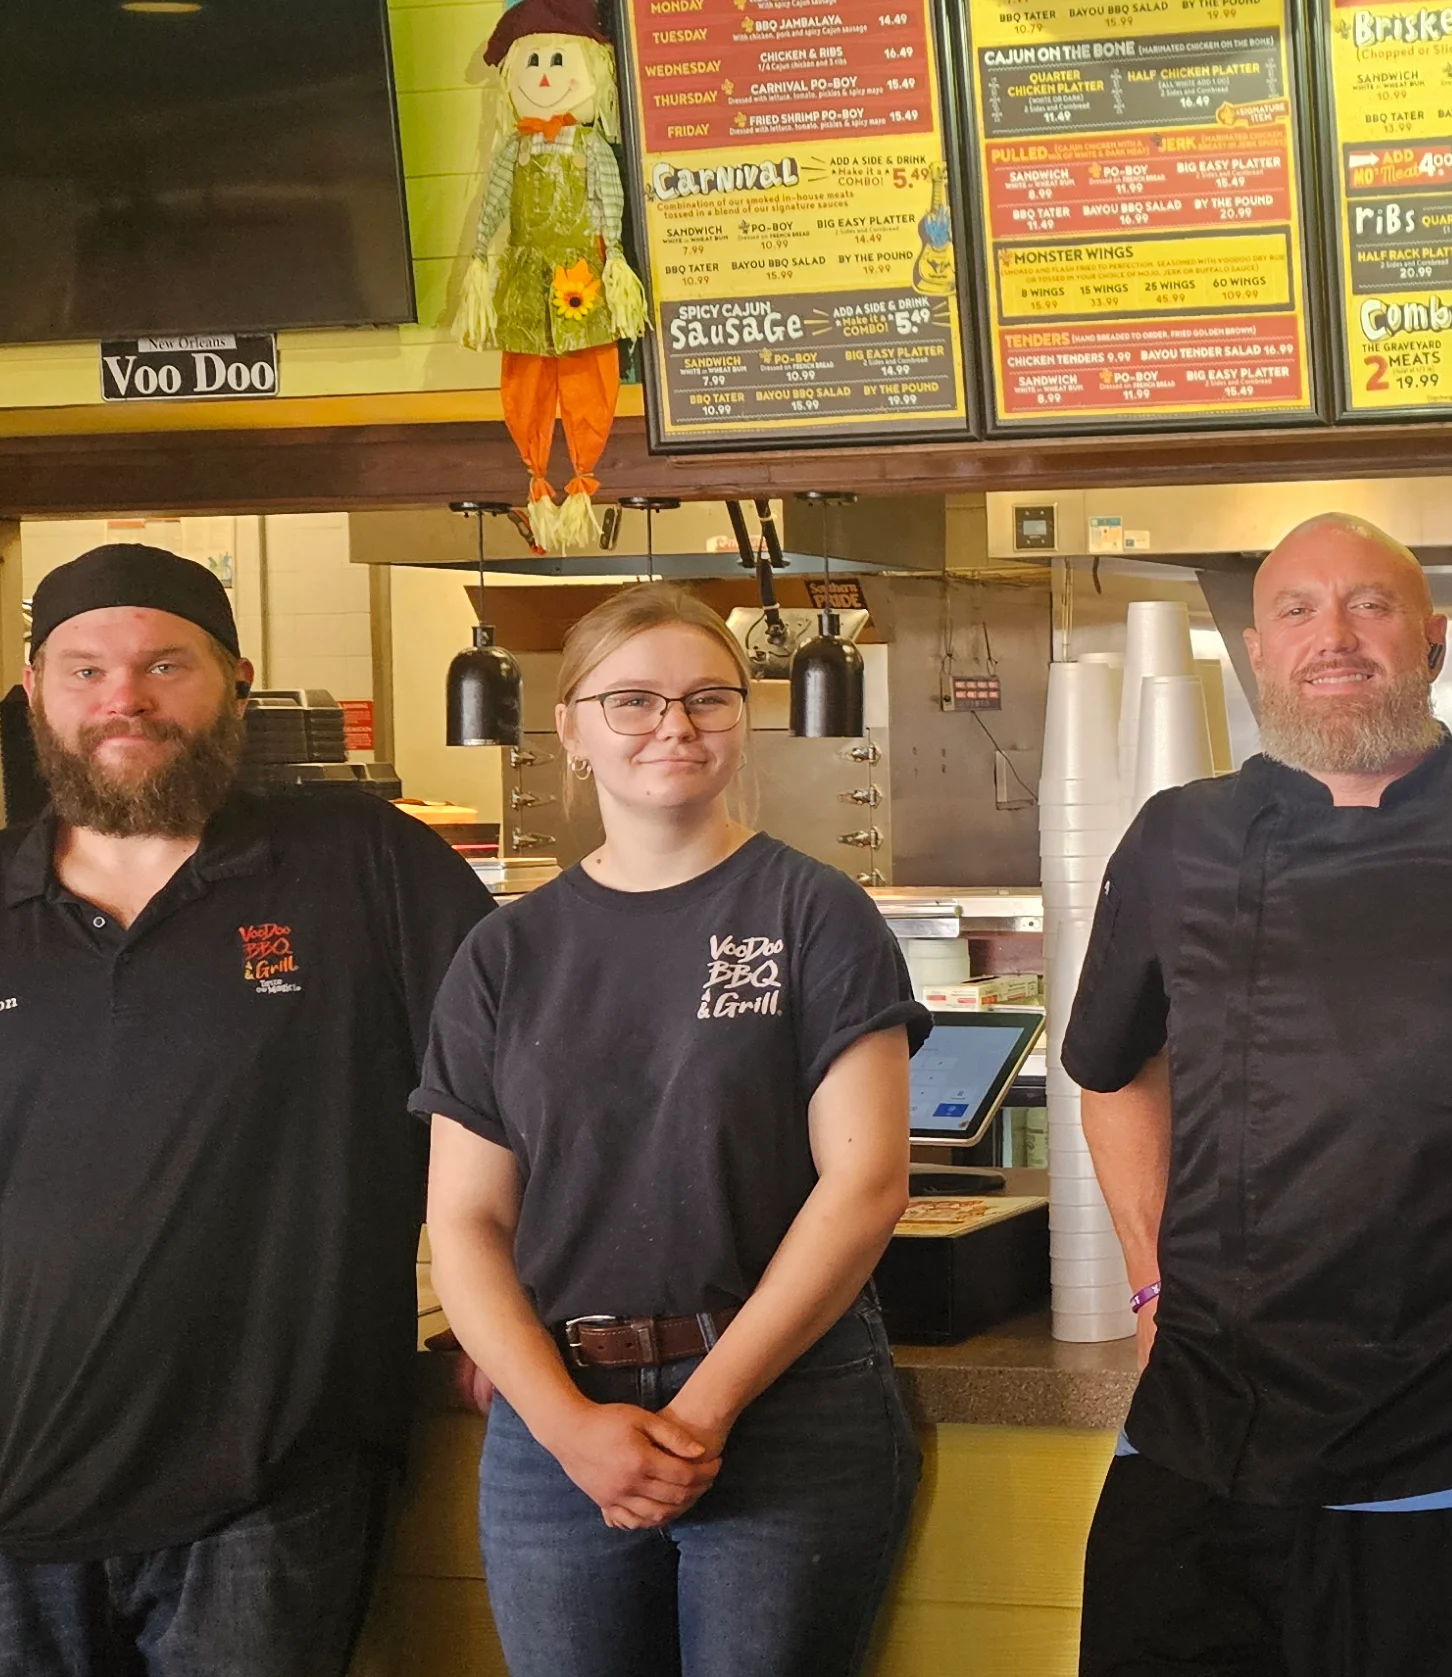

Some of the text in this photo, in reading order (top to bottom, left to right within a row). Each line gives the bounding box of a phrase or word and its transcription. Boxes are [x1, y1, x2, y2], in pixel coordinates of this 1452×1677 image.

[650, 0, 703, 14] MONDAY
[755, 15, 842, 32] BBQ JAMBALAYA
[878, 14, 908, 26] 14.49
[652, 28, 708, 44] TUESDAY
[760, 46, 843, 62] CHICKEN & RIBS
[884, 47, 914, 59] 16.49
[984, 41, 1135, 65] CAJUN ON THE BONE
[1356, 47, 1414, 61] (Chopped
[1418, 47, 1429, 55] or
[645, 60, 721, 77] WEDNESDAY
[1030, 70, 1080, 83] QUARTER
[1007, 80, 1105, 97] CHICKEN PLATTER
[653, 91, 718, 107] THURSDAY
[749, 108, 864, 126] FRIED SHRIMP PO-BOY
[889, 110, 918, 122] 15.49
[1044, 111, 1072, 122] 11.49
[667, 123, 710, 138] FRIDAY
[1159, 136, 1197, 152] JERK
[991, 146, 1048, 163] PULLED
[1382, 149, 1414, 164] ADD
[657, 200, 714, 211] Combination
[746, 195, 780, 205] smoked
[782, 193, 825, 202] in-house
[827, 191, 854, 199] meats
[1014, 246, 1134, 264] MONSTER WINGS
[679, 301, 771, 320] SPICY CAJUN
[149, 333, 226, 350] New Orleans
[1005, 332, 1070, 348] TENDERS
[1362, 340, 1442, 353] THE GRAVEYARD
[1007, 352, 1131, 368] CHICKEN TENDERS 9.99
[103, 352, 275, 396] Voo Doo
[1363, 351, 1441, 391] 2 MEATS
[1396, 374, 1439, 389] 19.99
[810, 583, 858, 593] Sothern
[243, 937, 294, 960] BBQ
[709, 935, 783, 963] VooDoo
[256, 956, 293, 979] Grill
[702, 960, 781, 988] BBQ
[713, 990, 780, 1018] Grill
